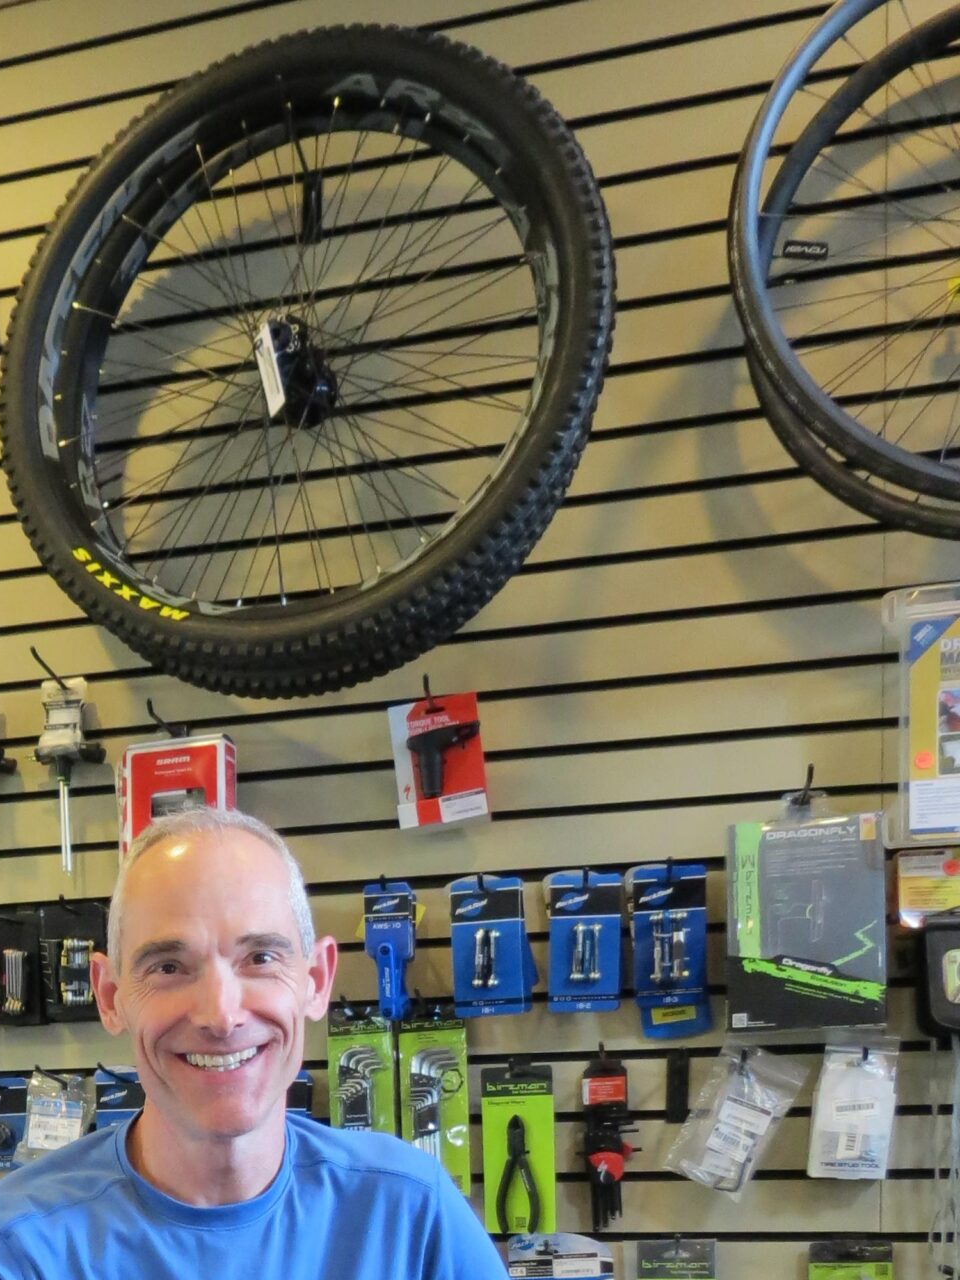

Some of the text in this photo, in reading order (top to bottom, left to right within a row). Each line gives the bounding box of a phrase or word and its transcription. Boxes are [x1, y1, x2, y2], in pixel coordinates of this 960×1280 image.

[72, 547, 190, 621] MAXXIS
[156, 755, 190, 766] SRAM
[766, 825, 857, 841] DRAGONFLY
[372, 922, 401, 930] AWS-10
[486, 1081, 547, 1092] birzman
[641, 1259, 709, 1270] birzman
